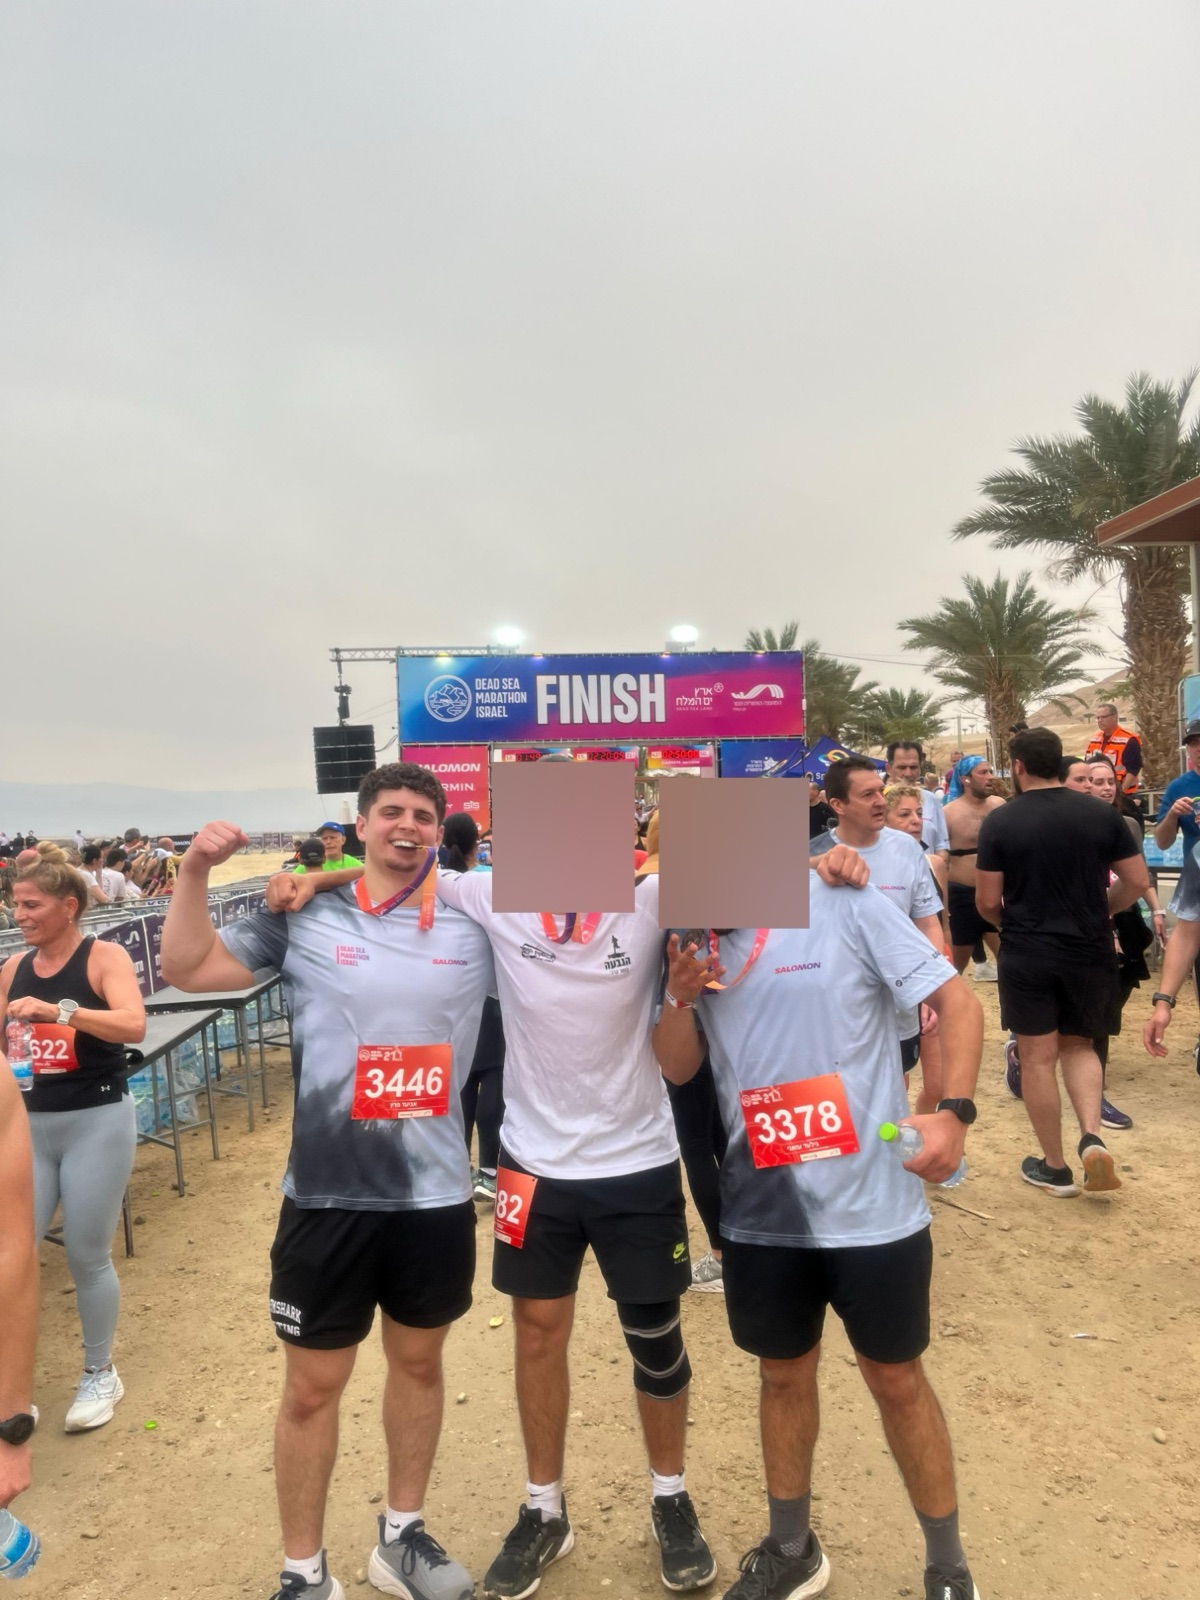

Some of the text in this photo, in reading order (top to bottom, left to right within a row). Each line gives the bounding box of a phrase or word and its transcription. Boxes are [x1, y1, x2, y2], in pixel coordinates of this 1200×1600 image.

[475, 677, 520, 690] DEAD SEA
[475, 691, 527, 704] MARATHON
[535, 672, 666, 725] FINISH
[694, 687, 713, 698] ארץ
[676, 695, 713, 707] ים המלח
[476, 705, 508, 718] ISRAEL
[419, 763, 481, 773] ALOMON
[442, 783, 475, 791] RMIN
[340, 945, 366, 954] DEAD SEA
[340, 952, 370, 961] MARATHON
[432, 958, 468, 966] SALOMON
[604, 956, 632, 970] הגבעה
[774, 962, 821, 975] SALOMON
[29, 1039, 69, 1059] 622
[364, 1066, 444, 1099] 3446
[754, 1100, 842, 1144] 3378
[496, 1190, 523, 1226] 82
[275, 1321, 301, 1337] TING
